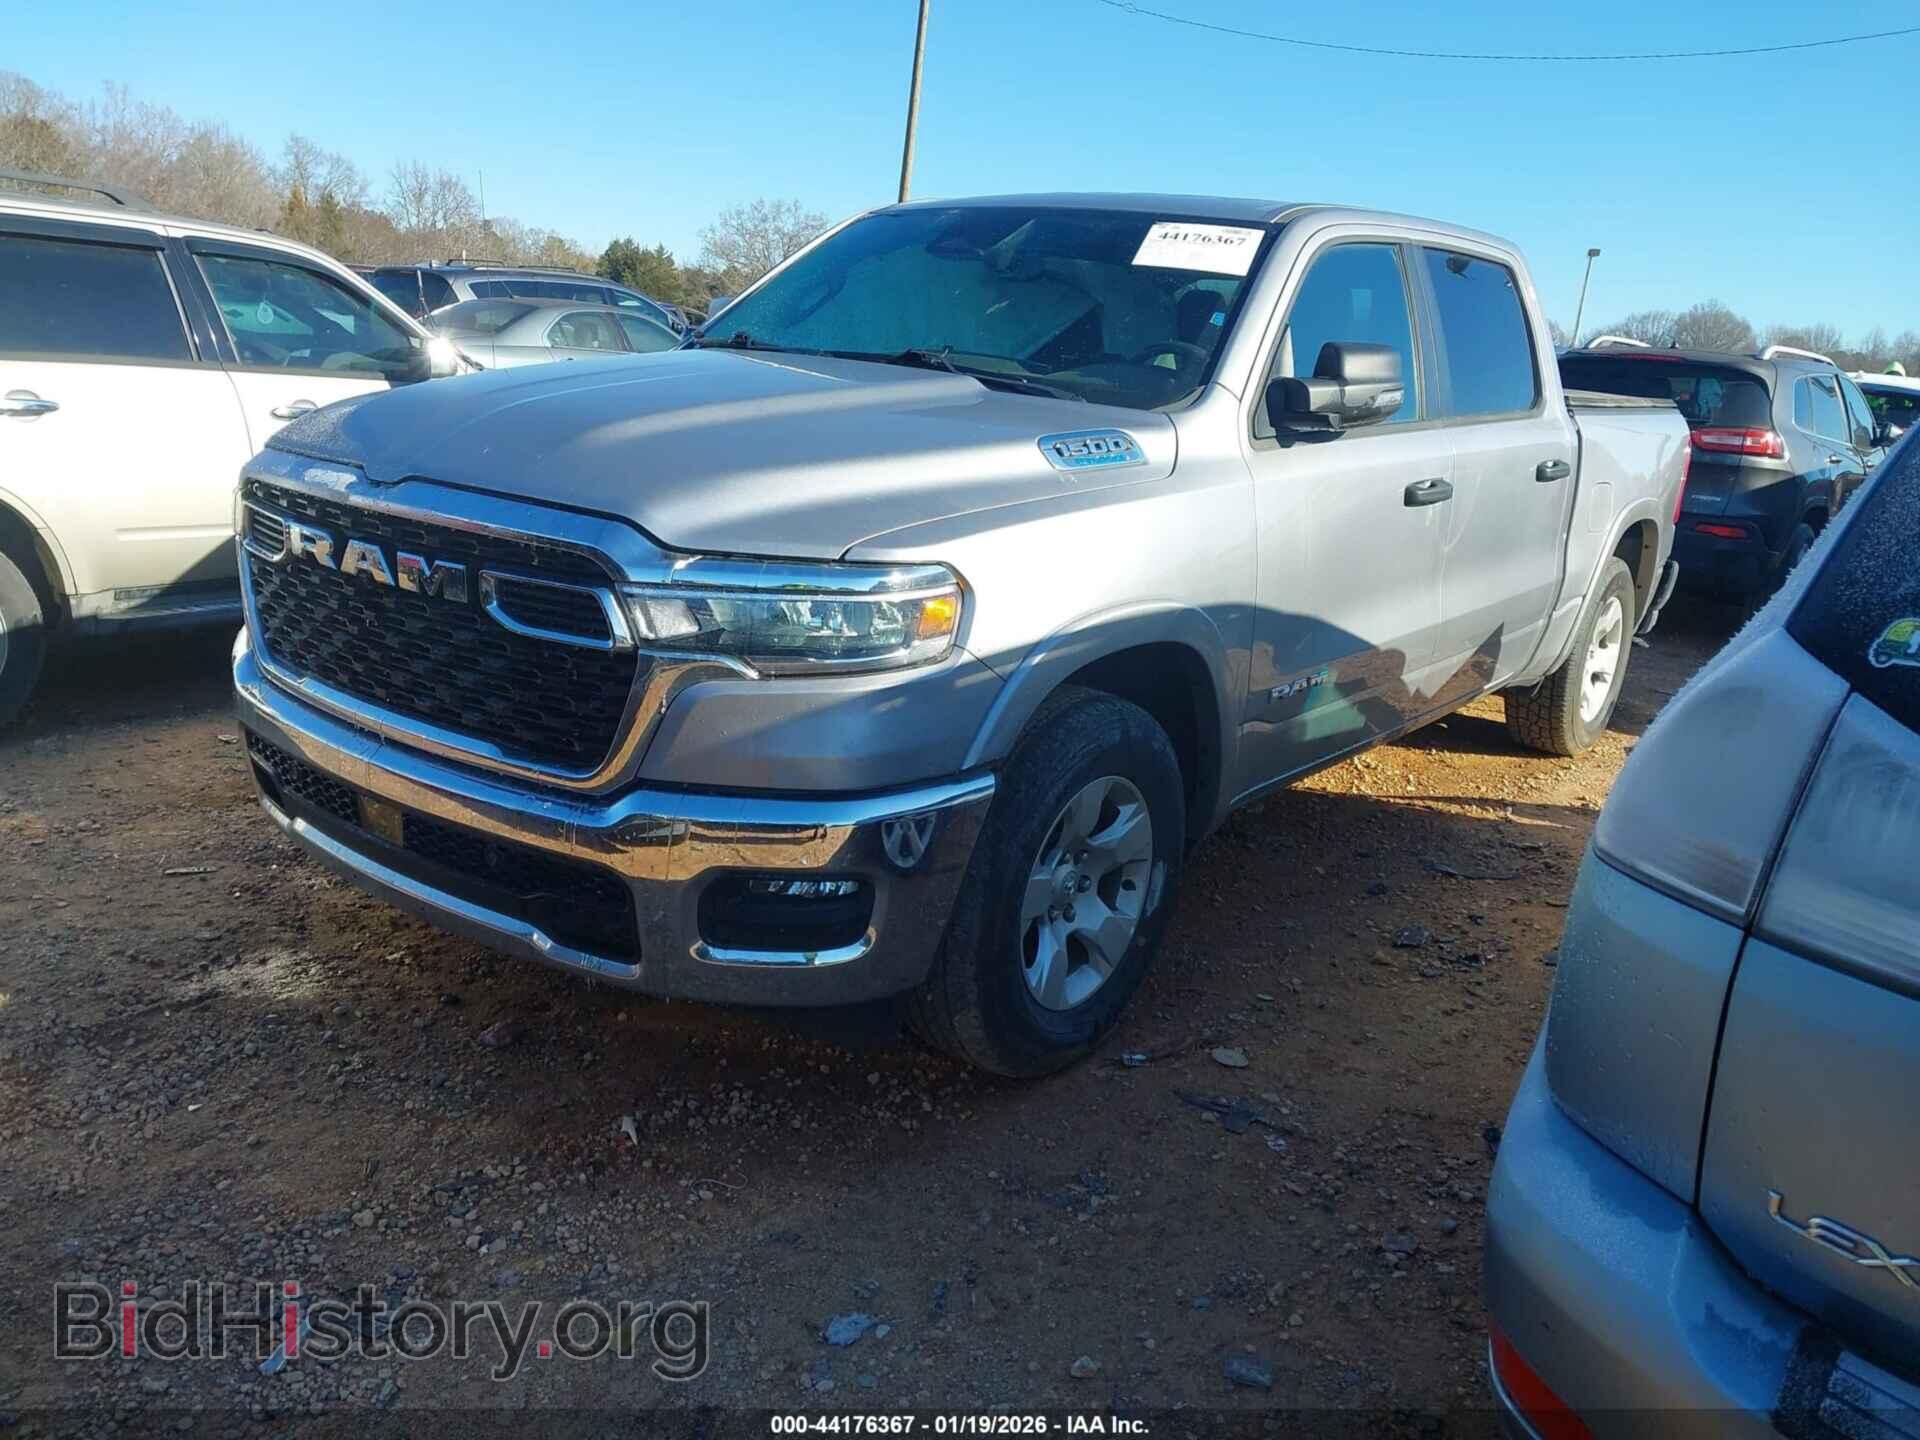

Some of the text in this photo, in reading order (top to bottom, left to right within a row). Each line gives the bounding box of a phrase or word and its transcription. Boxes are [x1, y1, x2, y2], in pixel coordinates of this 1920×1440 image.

[1157, 231, 1247, 247] 44176367
[1053, 438, 1126, 457] 1500
[286, 521, 468, 603] RAM
[1268, 671, 1329, 699] RAM
